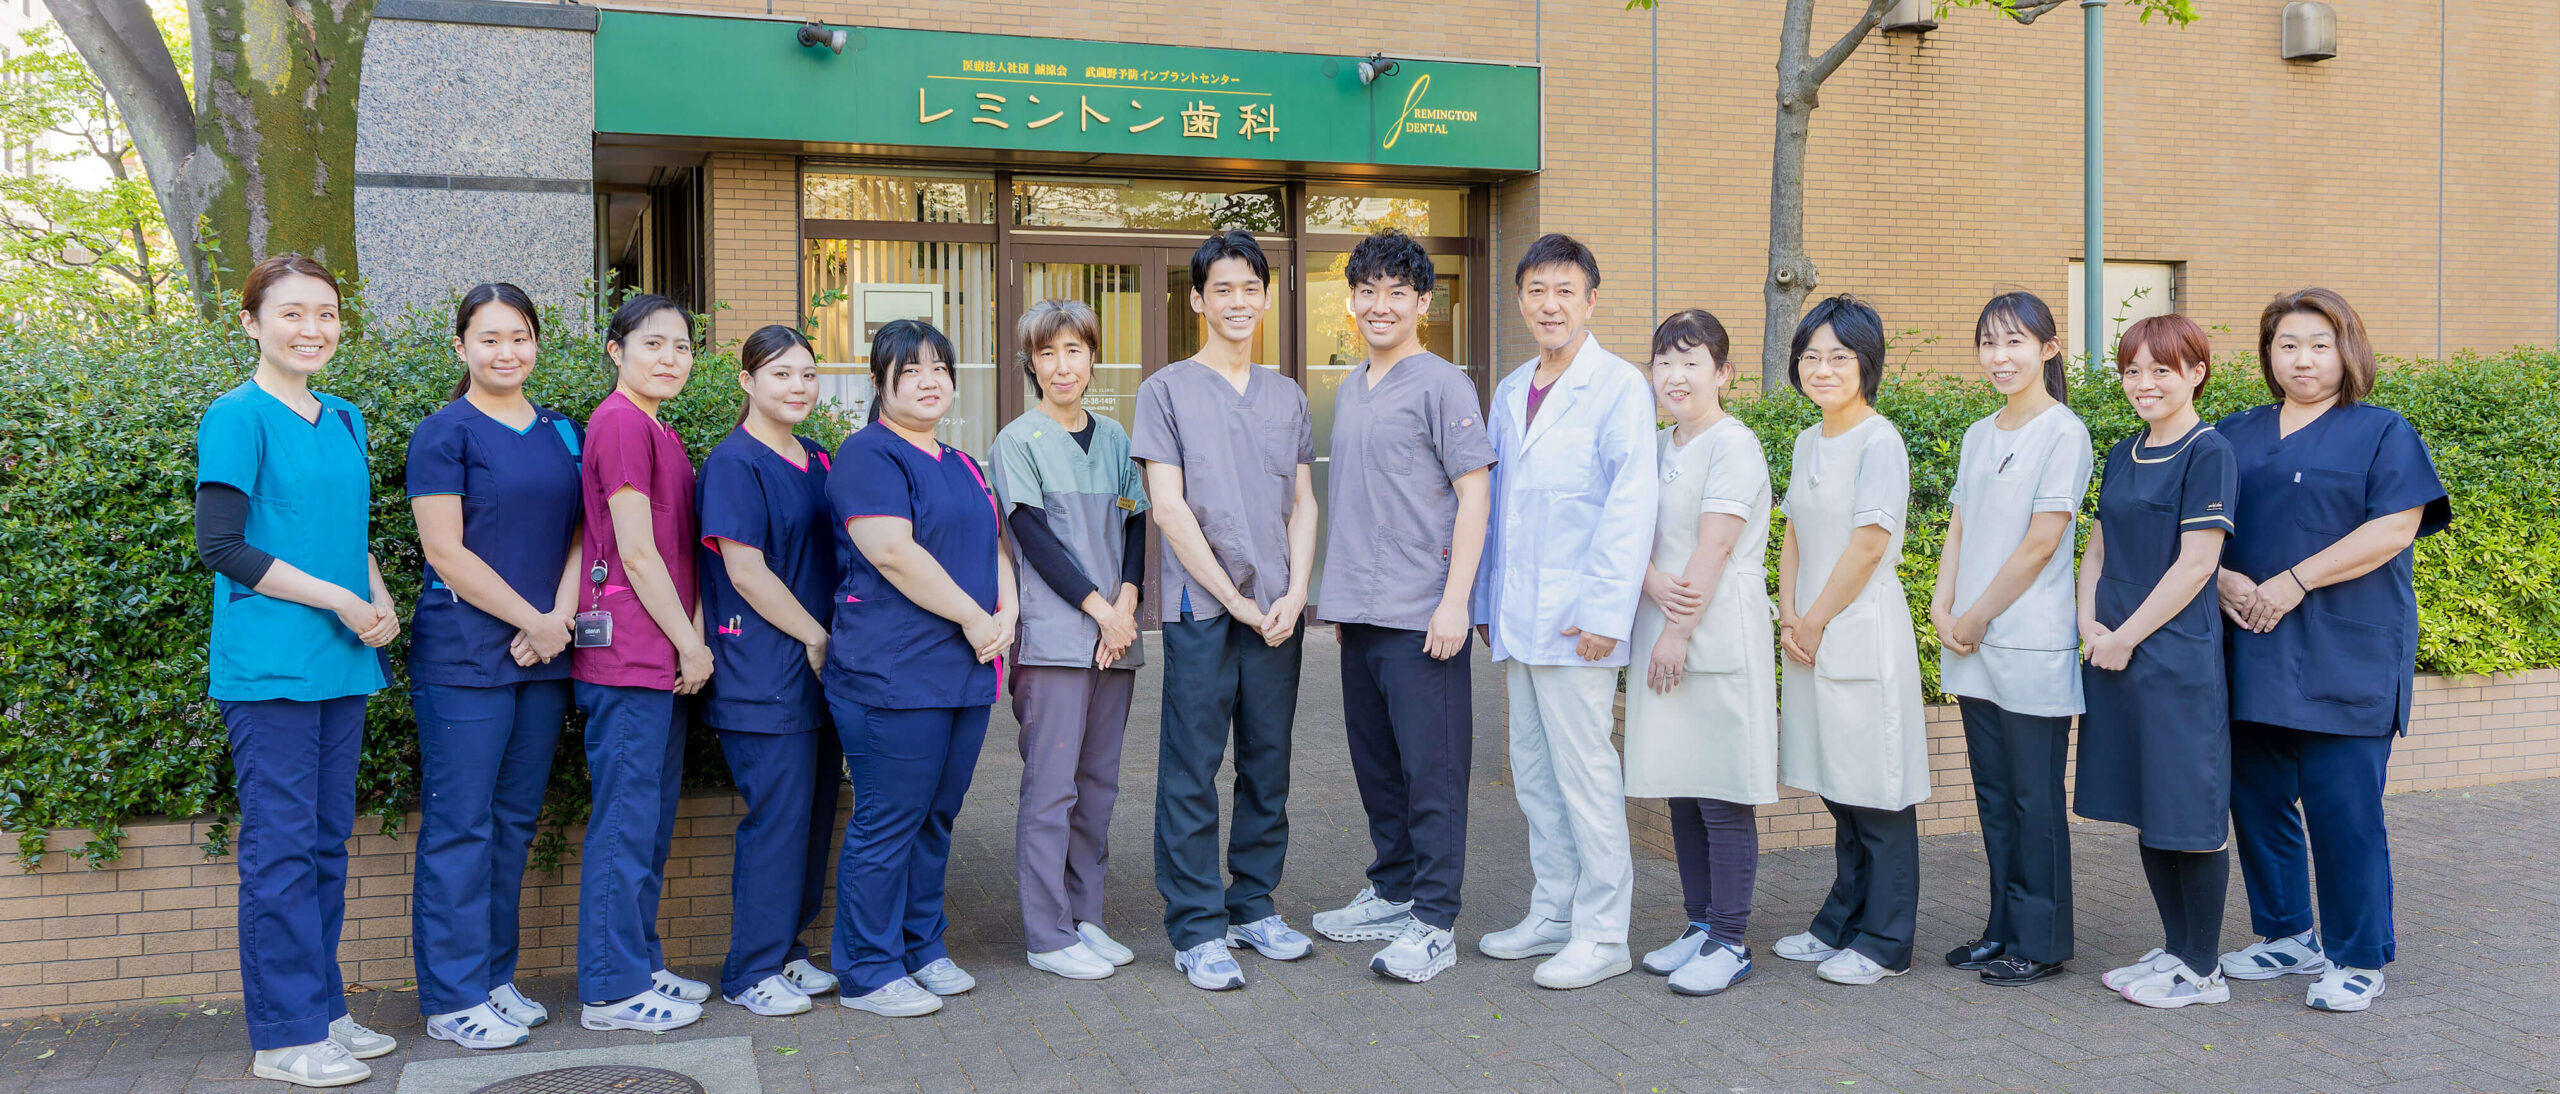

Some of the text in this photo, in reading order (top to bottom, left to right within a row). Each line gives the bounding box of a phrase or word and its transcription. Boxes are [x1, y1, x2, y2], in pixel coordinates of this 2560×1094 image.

[963, 60, 1029, 74] 医療法人社団
[919, 88, 1280, 142] レミントン歯科
[1413, 108, 1478, 121] REMINGTON
[1406, 122, 1448, 135] DENTAL
